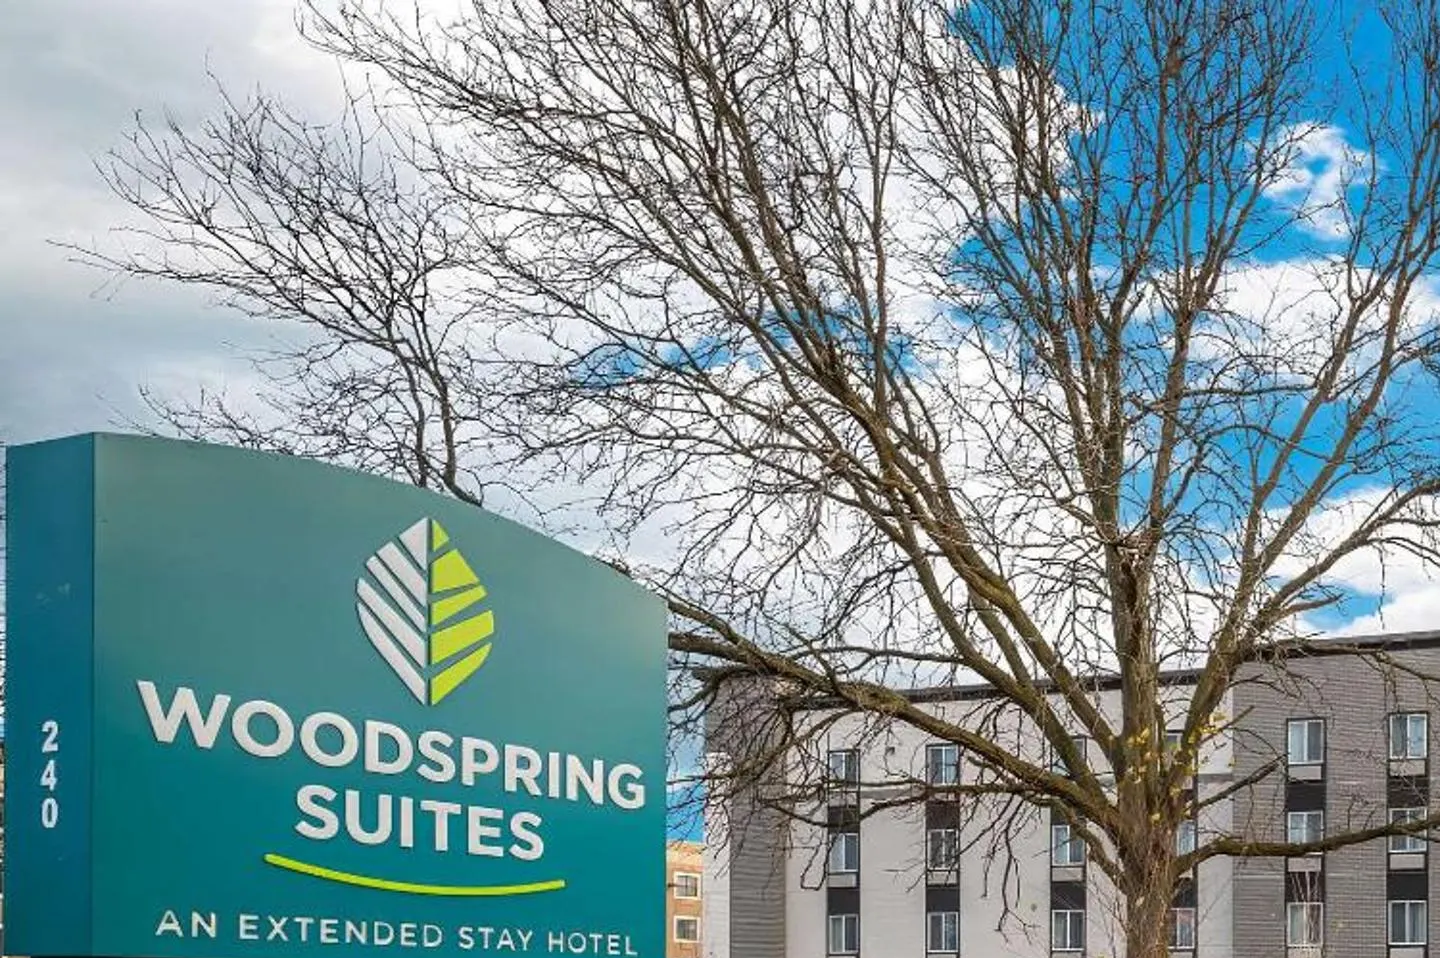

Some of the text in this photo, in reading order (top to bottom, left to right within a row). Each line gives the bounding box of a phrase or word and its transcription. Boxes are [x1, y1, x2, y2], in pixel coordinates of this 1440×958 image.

[40, 719, 59, 829] 240
[136, 680, 646, 810] WOODSPRING
[294, 784, 545, 861] SUITES
[155, 910, 638, 956] AN EXTENDED STAY HOTEL
